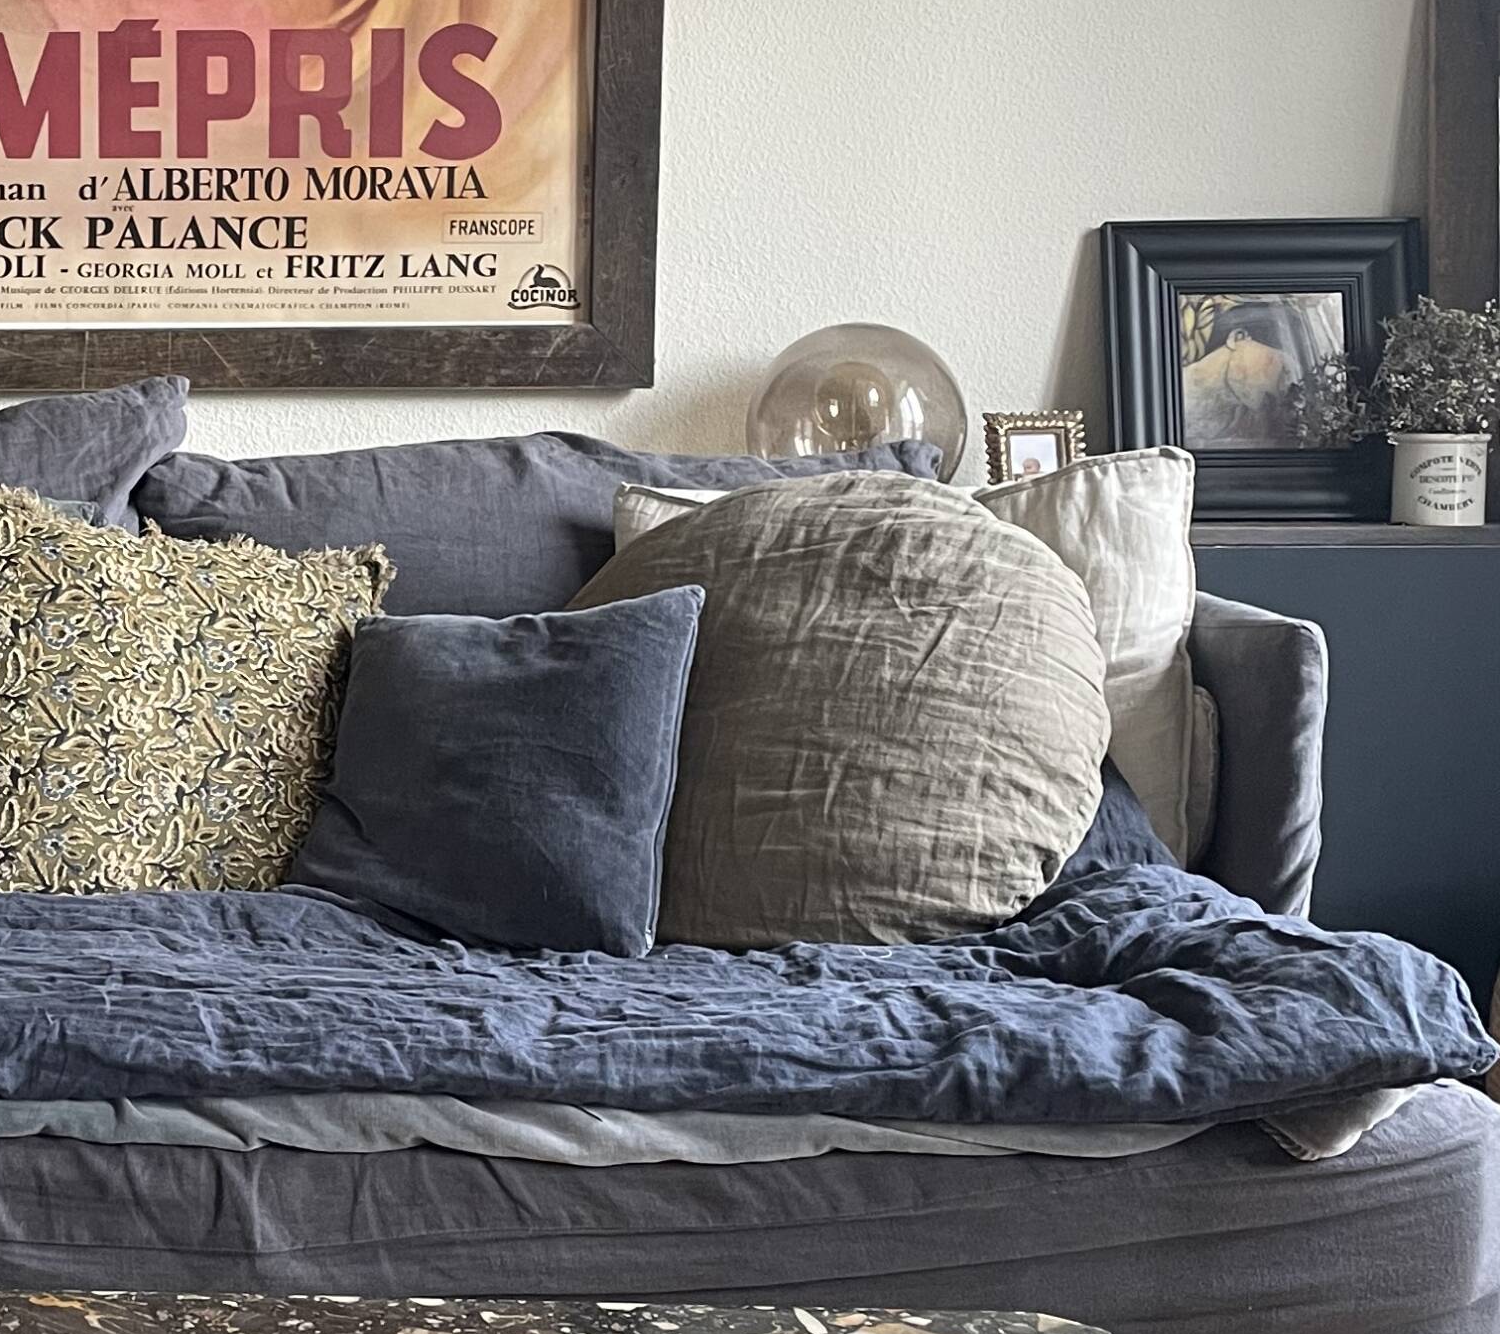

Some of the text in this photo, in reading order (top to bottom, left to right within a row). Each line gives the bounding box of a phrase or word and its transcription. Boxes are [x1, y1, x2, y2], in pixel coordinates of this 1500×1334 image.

[302, 164, 490, 201] MORAVIA
[112, 205, 135, 213] avec
[83, 215, 308, 250] PALANCE
[449, 219, 536, 236] FRANSCOPE
[77, 262, 174, 279] GEORGIA
[185, 263, 246, 279] MOLL
[256, 266, 274, 279] et
[284, 253, 385, 279] FRITZ
[399, 252, 498, 278] LANG
[1, 285, 41, 296] Musique
[44, 285, 56, 295] de
[59, 285, 109, 295] GEORGES
[113, 285, 163, 295] DELERUE
[268, 285, 314, 295] Directeur
[317, 285, 329, 295] de
[333, 285, 388, 295] Production
[392, 285, 443, 295] PHILIPPE
[448, 284, 496, 294] DUSSART
[510, 288, 578, 303] COCINOR
